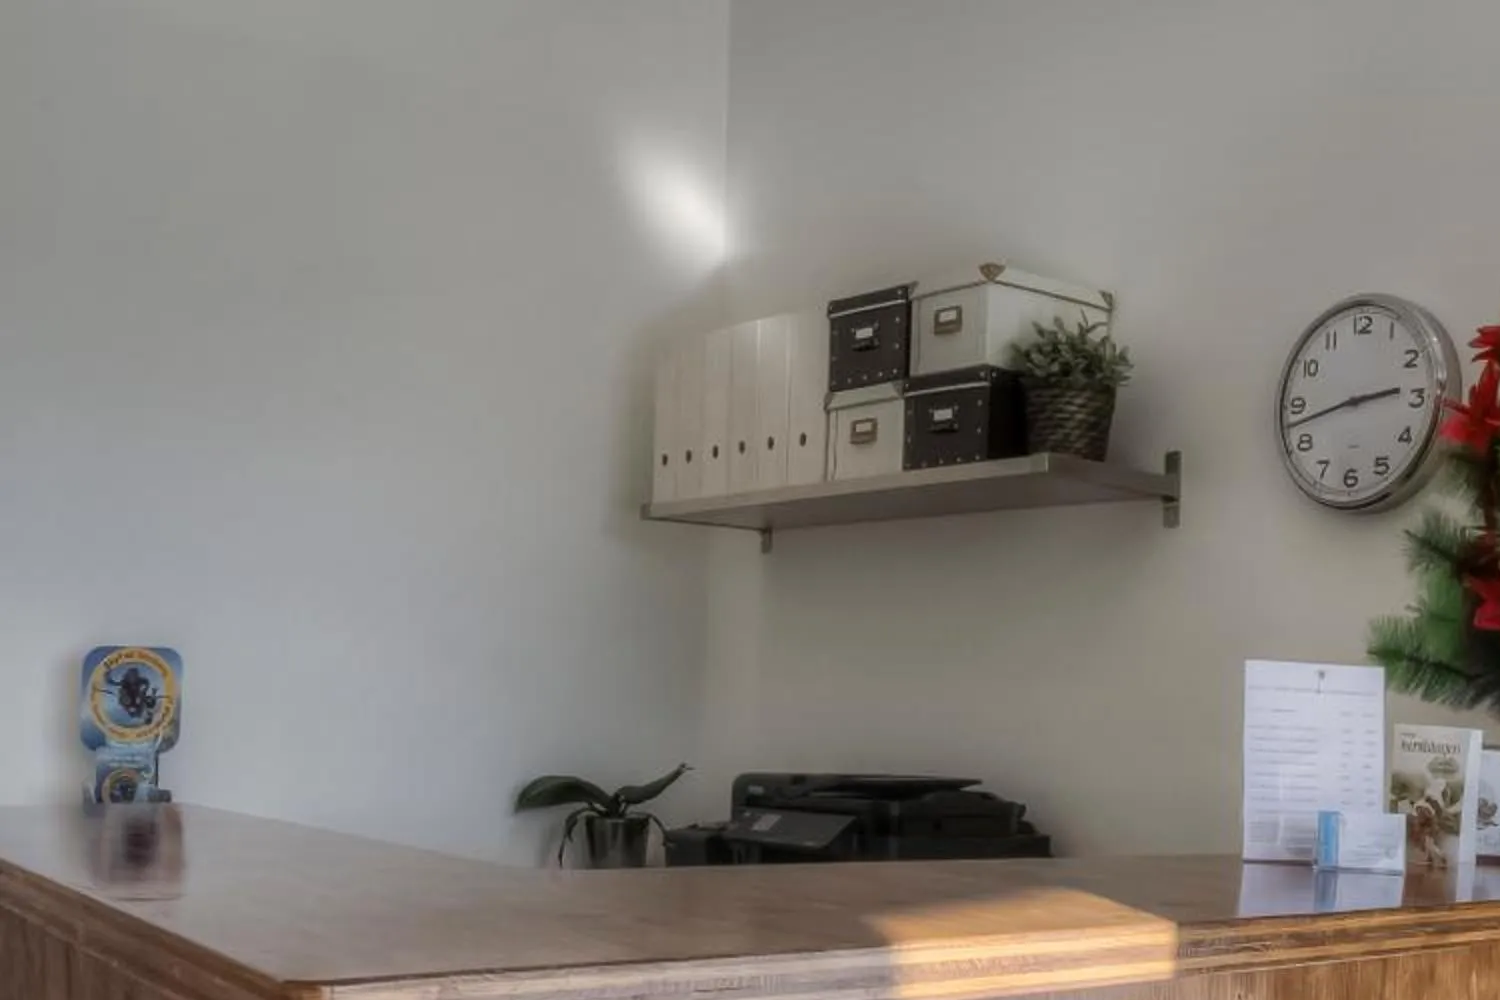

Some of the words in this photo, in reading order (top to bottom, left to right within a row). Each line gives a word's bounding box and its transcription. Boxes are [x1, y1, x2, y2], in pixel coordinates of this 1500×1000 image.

[1353, 316, 1373, 335] 12
[1325, 331, 1336, 350] 11
[1403, 350, 1418, 368] 2
[1303, 359, 1319, 378] 10
[1290, 398, 1306, 414] 9
[1408, 388, 1425, 408] 3
[1297, 434, 1313, 452] 8
[1398, 426, 1412, 444] 4
[1316, 460, 1330, 478] 7
[1373, 457, 1390, 475] 5
[1343, 469, 1358, 487] 6
